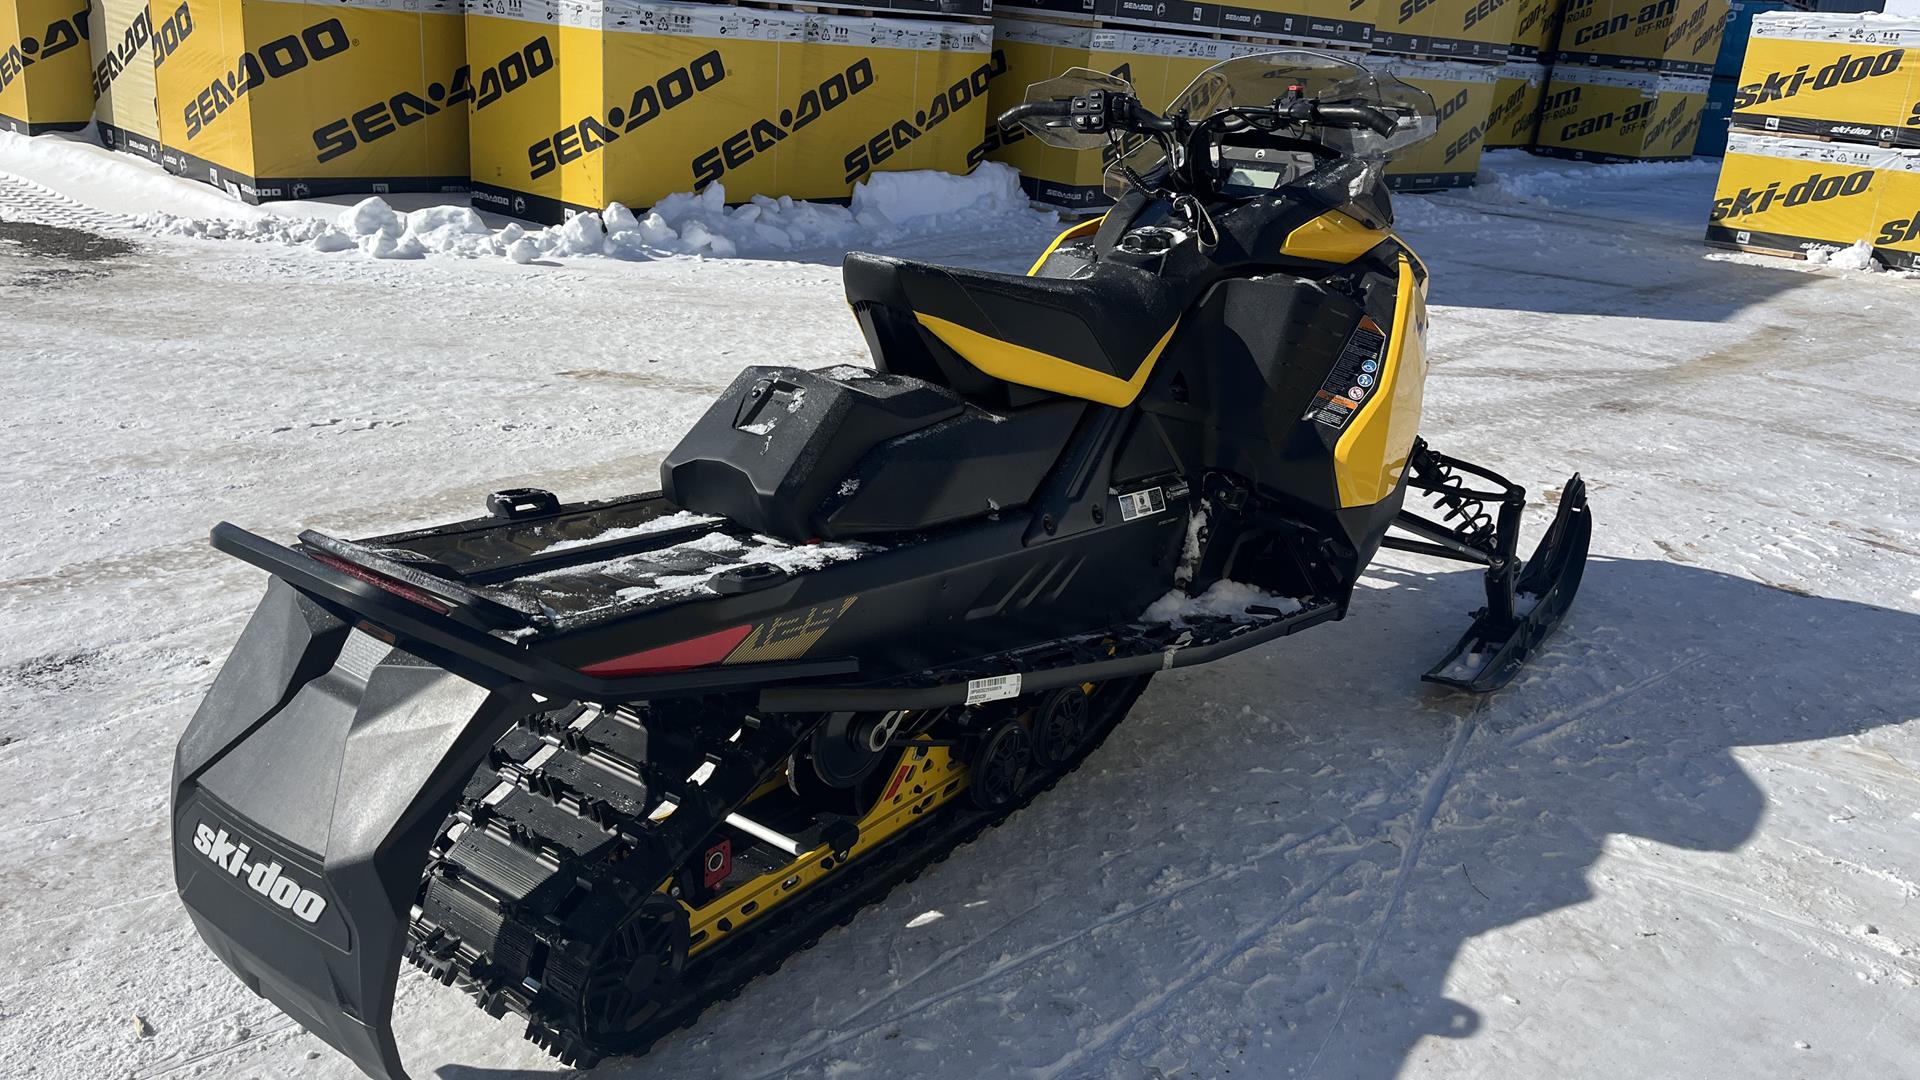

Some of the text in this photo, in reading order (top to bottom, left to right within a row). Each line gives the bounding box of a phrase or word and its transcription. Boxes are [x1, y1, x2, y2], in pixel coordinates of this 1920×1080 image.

[1734, 49, 1905, 109] ski-doo
[1830, 125, 1872, 136] ski-doo
[1711, 171, 1875, 221] ski-doo
[192, 823, 327, 923] ski-doo
